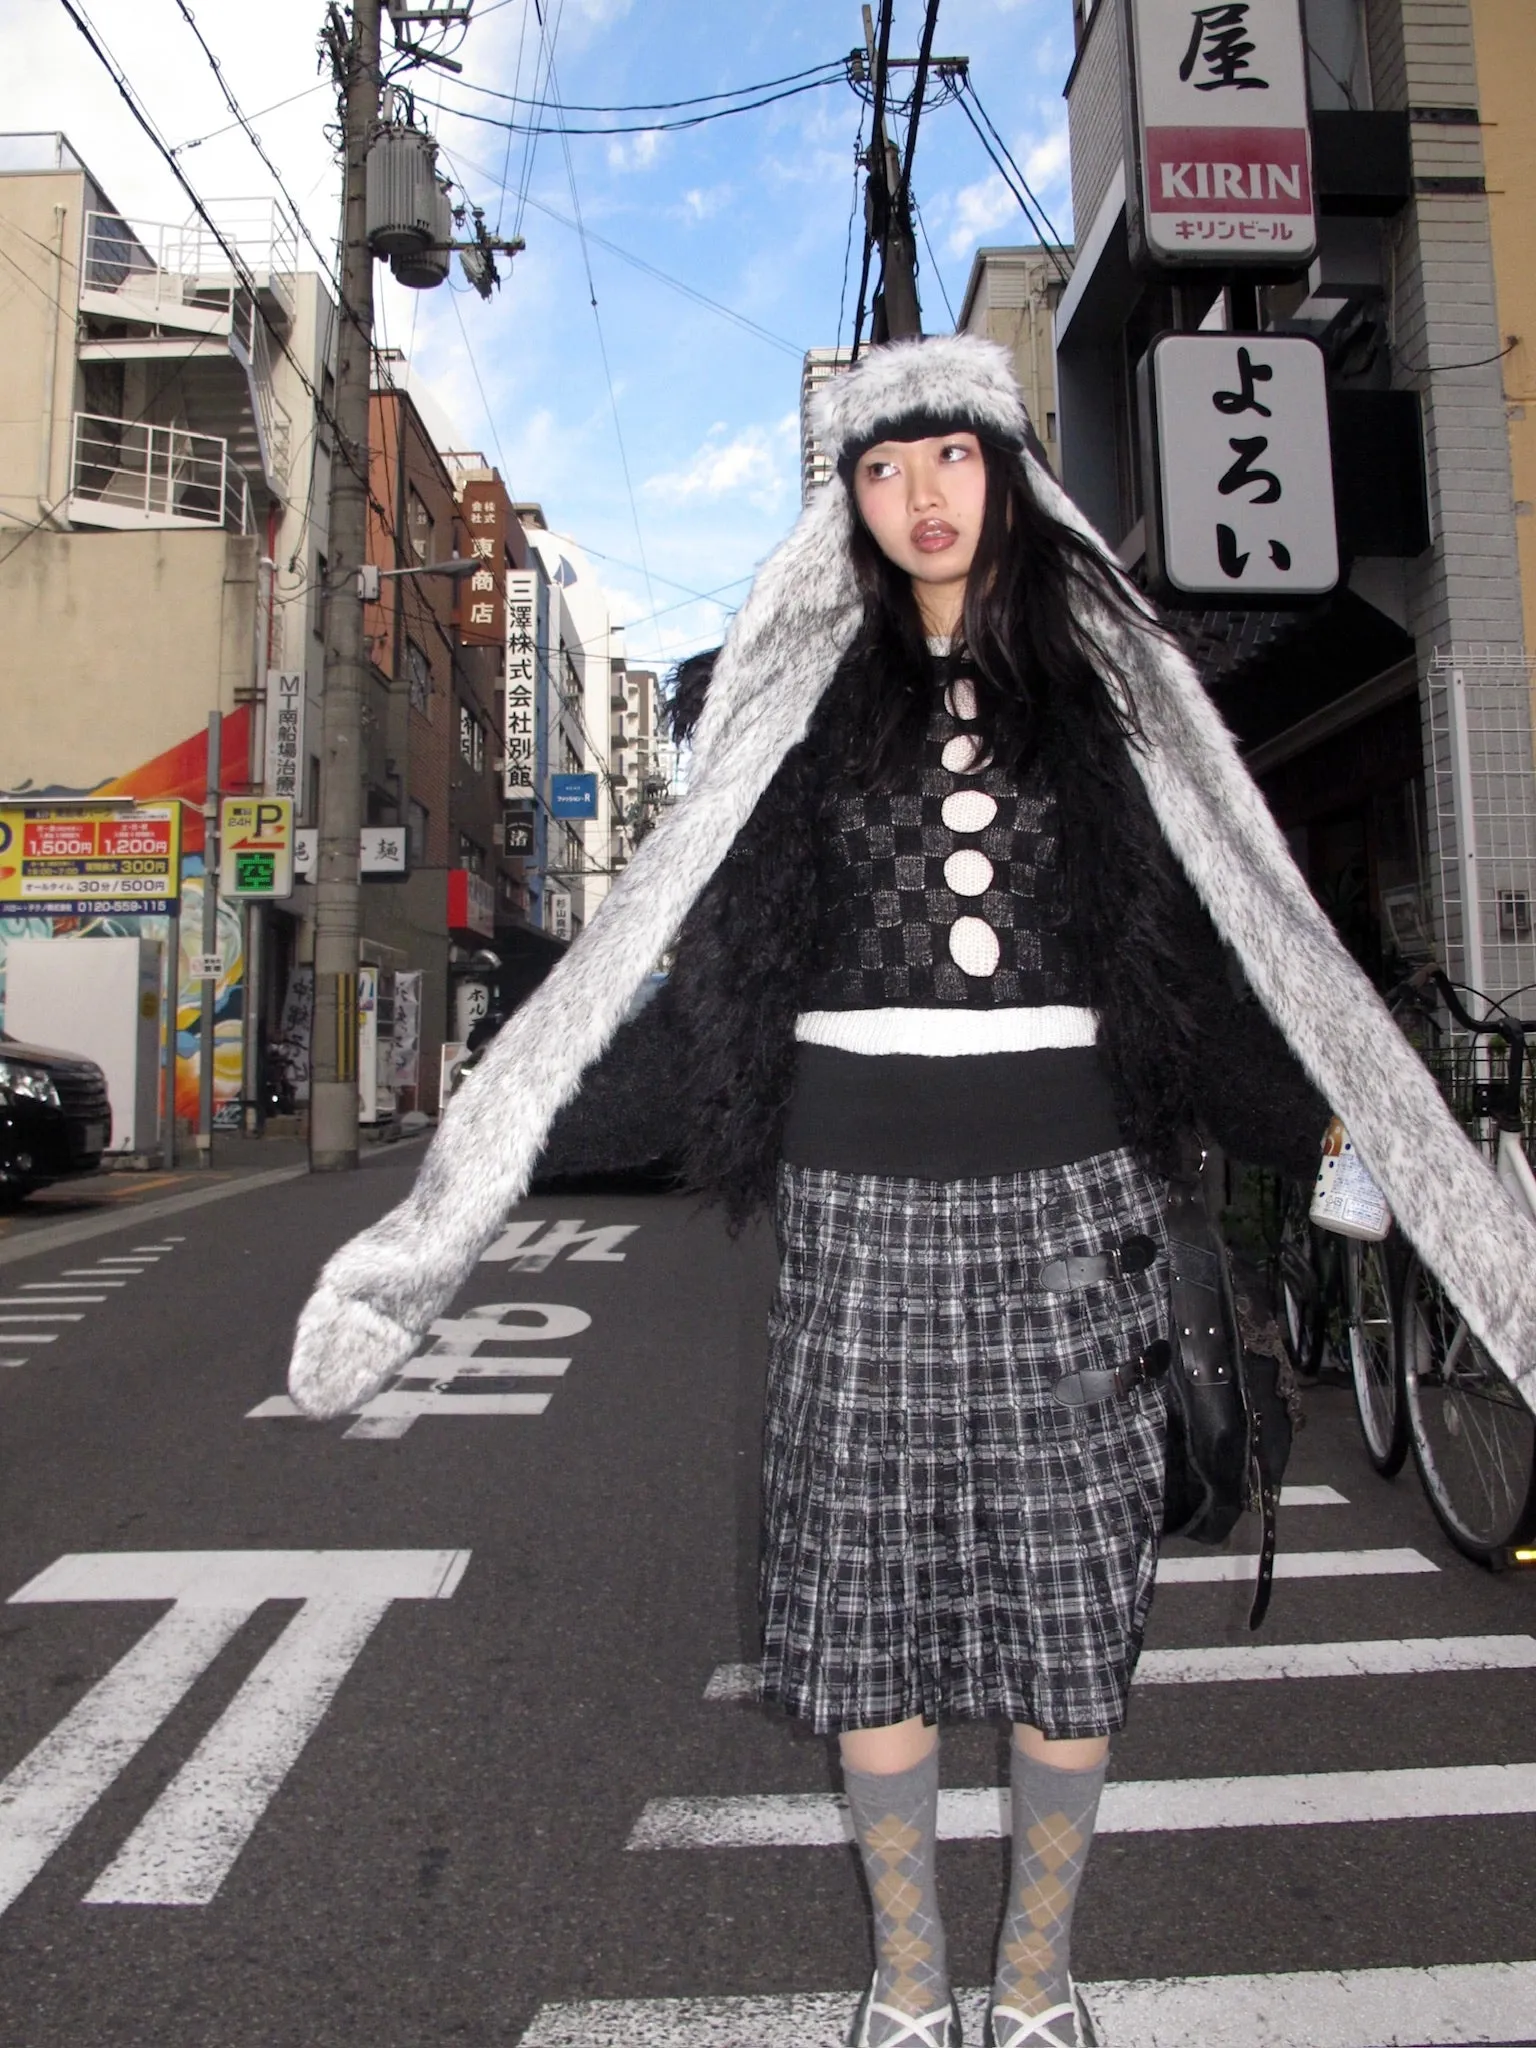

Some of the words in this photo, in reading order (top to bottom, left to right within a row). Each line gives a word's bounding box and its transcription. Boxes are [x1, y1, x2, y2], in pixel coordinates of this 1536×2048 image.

[1178, 3, 1270, 91] 屋
[1159, 162, 1301, 200] KIRIN
[1174, 219, 1294, 241] キリンビール
[1211, 346, 1292, 579] よろい
[470, 537, 496, 625] 東商店
[507, 579, 533, 788] 三澤株式会社別館
[276, 675, 300, 799] MT南船場治療
[254, 804, 283, 838] P
[29, 840, 93, 856] 1,500円
[104, 839, 168, 856] 1,200円
[120, 860, 167, 874] 300円
[237, 853, 275, 891] 空
